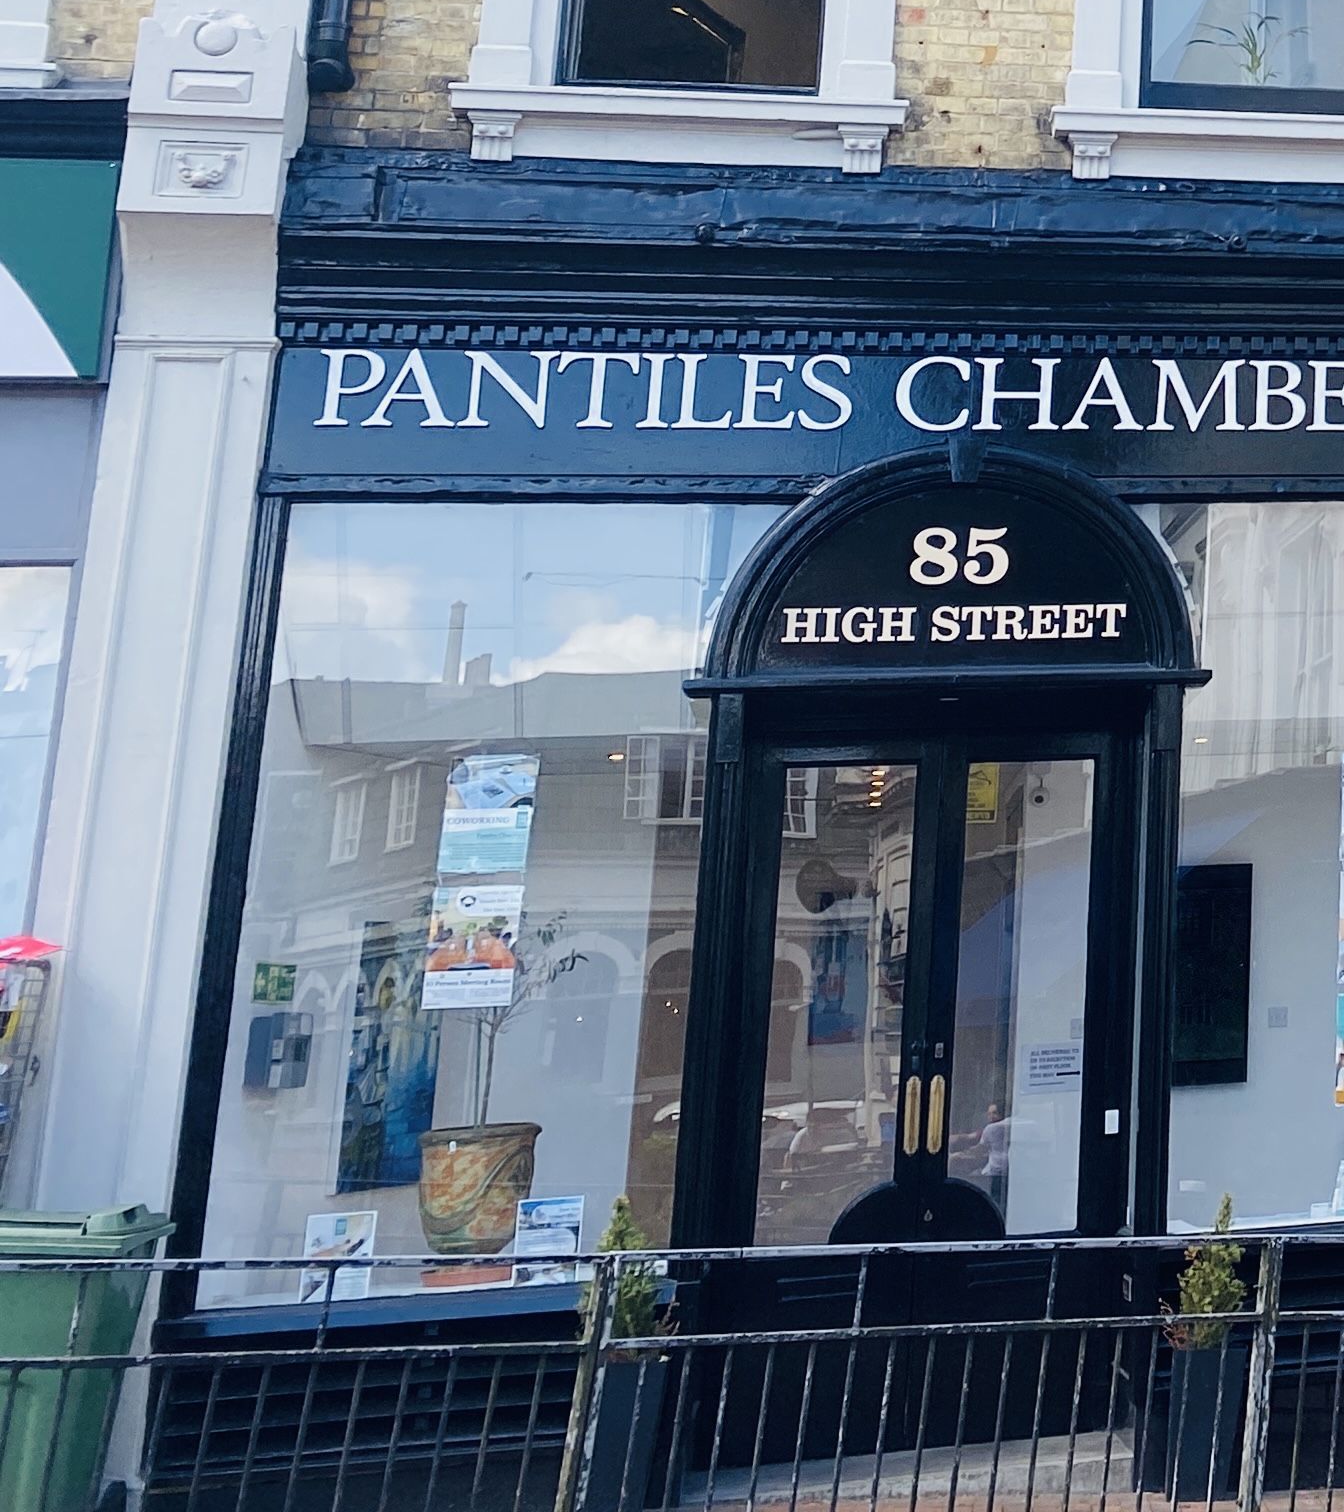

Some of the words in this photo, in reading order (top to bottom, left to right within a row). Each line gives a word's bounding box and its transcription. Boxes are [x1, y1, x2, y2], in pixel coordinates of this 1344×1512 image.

[313, 348, 853, 431] PANTILES
[909, 526, 1010, 586] 85
[781, 605, 916, 644] HIGH
[930, 603, 1127, 643] STREET
[446, 815, 511, 826] COWORKING
